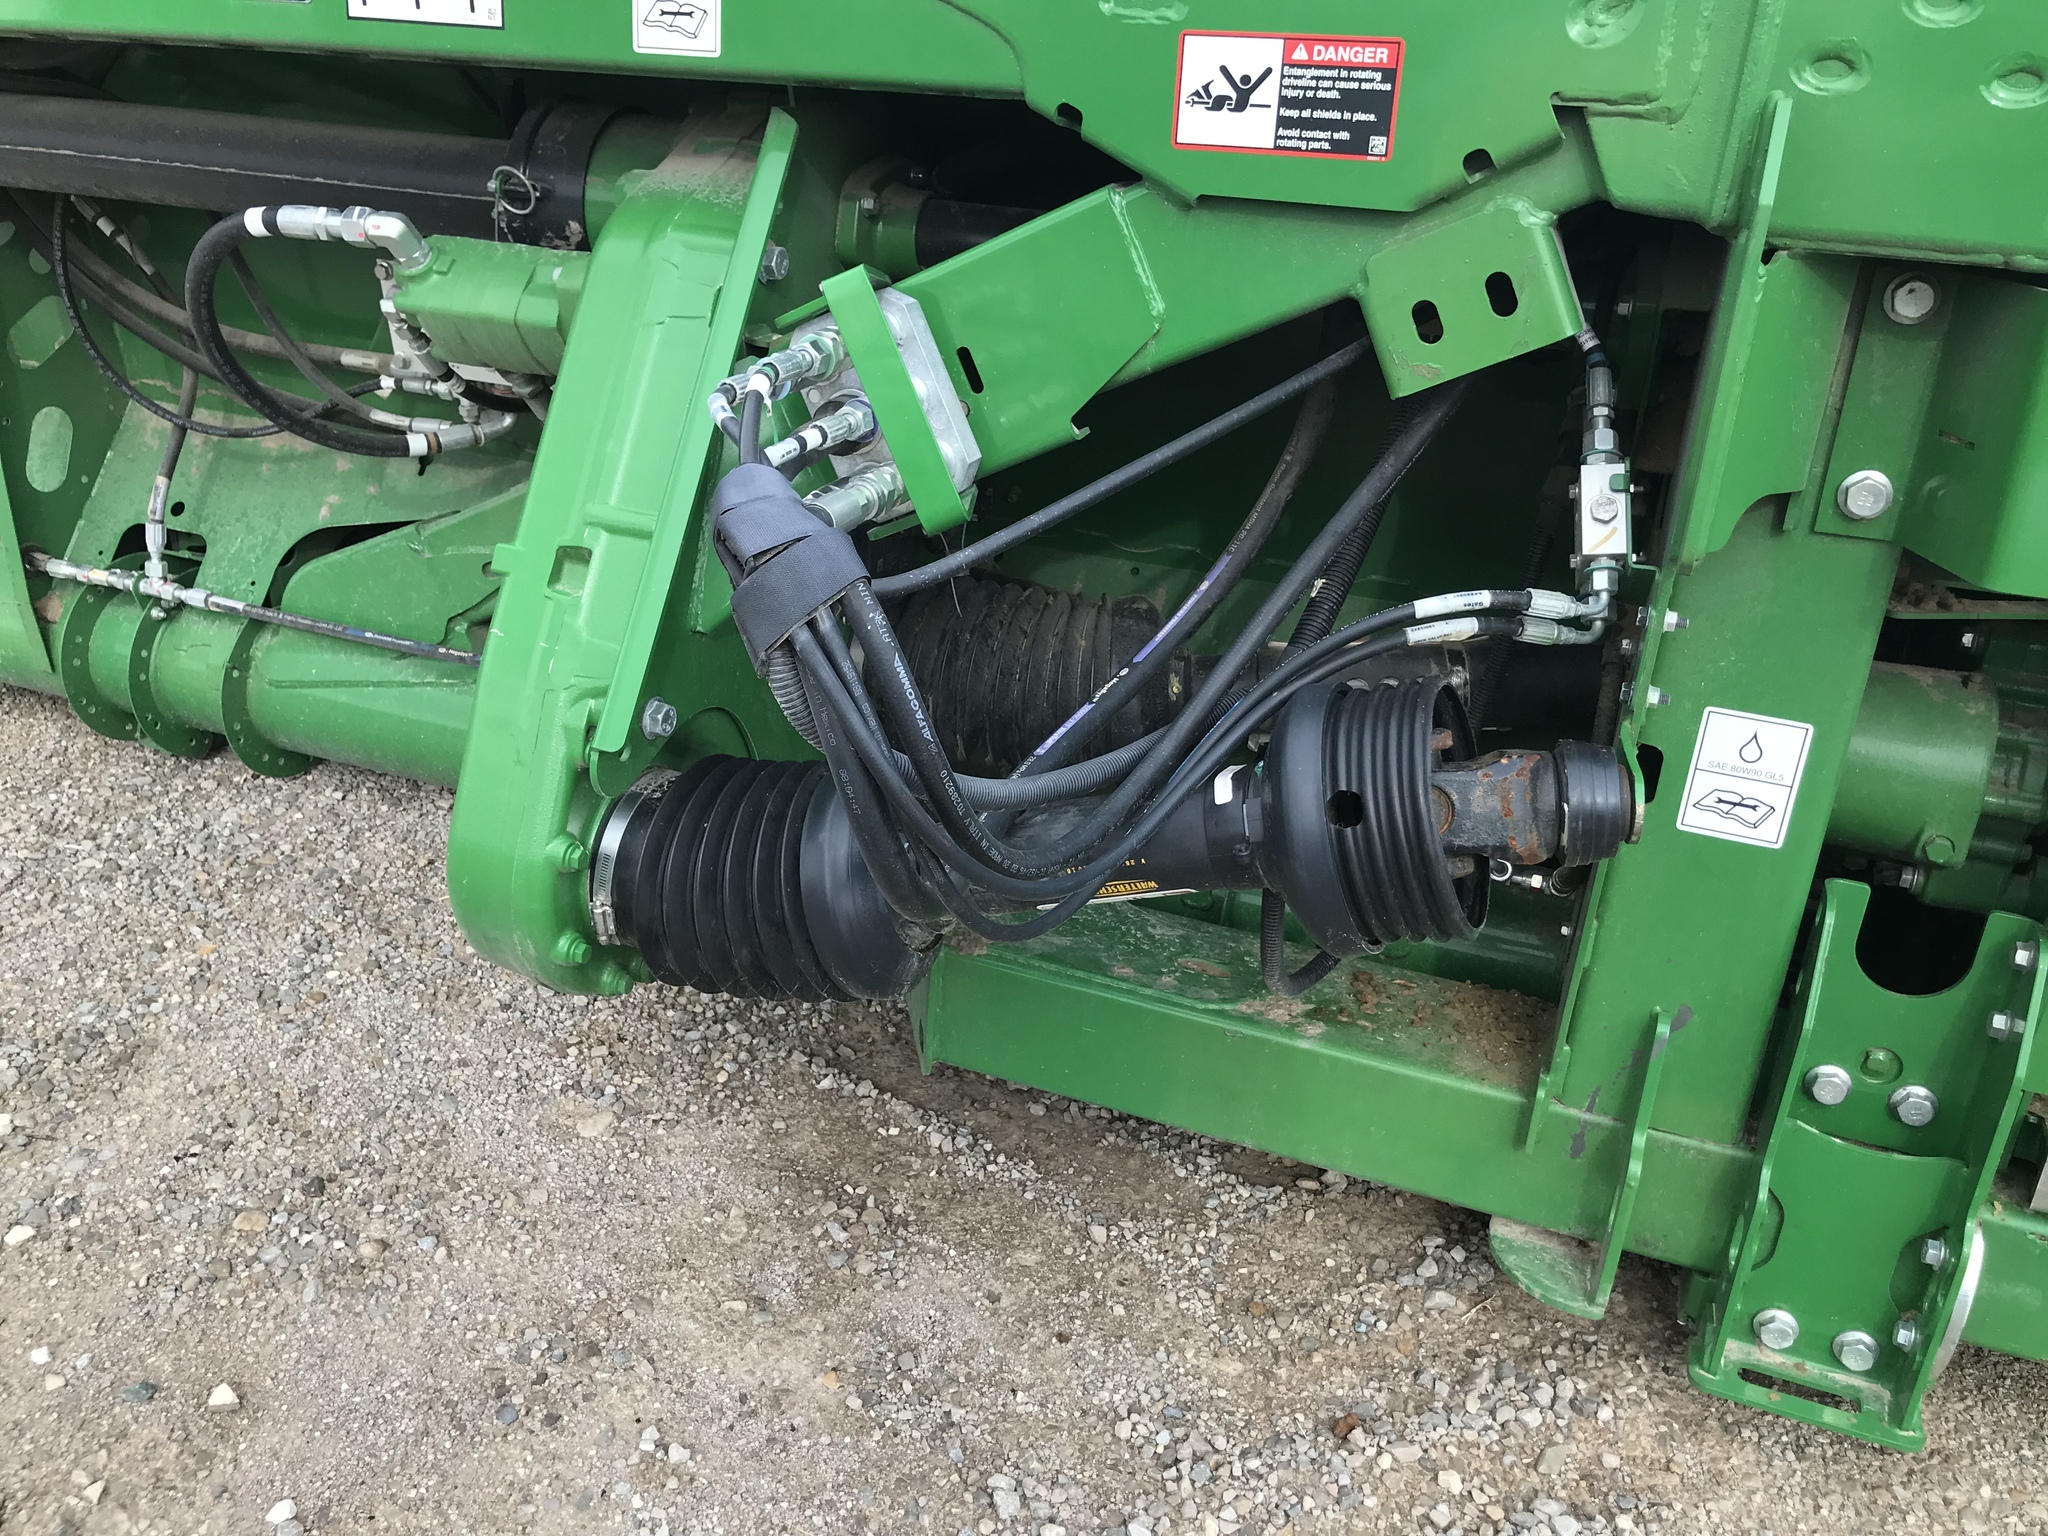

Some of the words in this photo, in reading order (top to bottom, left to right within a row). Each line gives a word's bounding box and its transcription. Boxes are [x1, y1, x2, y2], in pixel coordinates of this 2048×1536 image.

[1313, 45, 1388, 63] DANGER
[1283, 66, 1339, 78] Entanglement
[1340, 69, 1348, 78] in
[1350, 70, 1382, 81] rotating
[1282, 77, 1317, 87] driveline
[1334, 81, 1359, 89] cause
[1361, 81, 1392, 91] serious
[1281, 87, 1304, 99] injury
[1316, 89, 1341, 99] death.
[1279, 107, 1300, 119] Keep
[1301, 108, 1311, 118] all
[1312, 109, 1341, 120] shields
[1343, 110, 1351, 120] in
[1352, 111, 1377, 122] place.
[1277, 127, 1300, 137] Avoid
[1301, 130, 1332, 140] contact
[1333, 131, 1350, 140] with
[1276, 138, 1307, 150] rotating
[1308, 140, 1331, 150] parts.
[1245, 512, 1258, 530] MSHA
[894, 651, 935, 742] ALFAGOMMA
[819, 706, 836, 746] Mexico
[1708, 760, 1728, 771] SAE
[1730, 765, 1763, 777] 80W90
[1765, 771, 1784, 781] GL5
[940, 769, 966, 816] T0289210
[964, 818, 982, 840] ITALY
[980, 839, 989, 851] IN
[988, 848, 1003, 863] MADE
[1096, 880, 1158, 894] WALTERSCH
